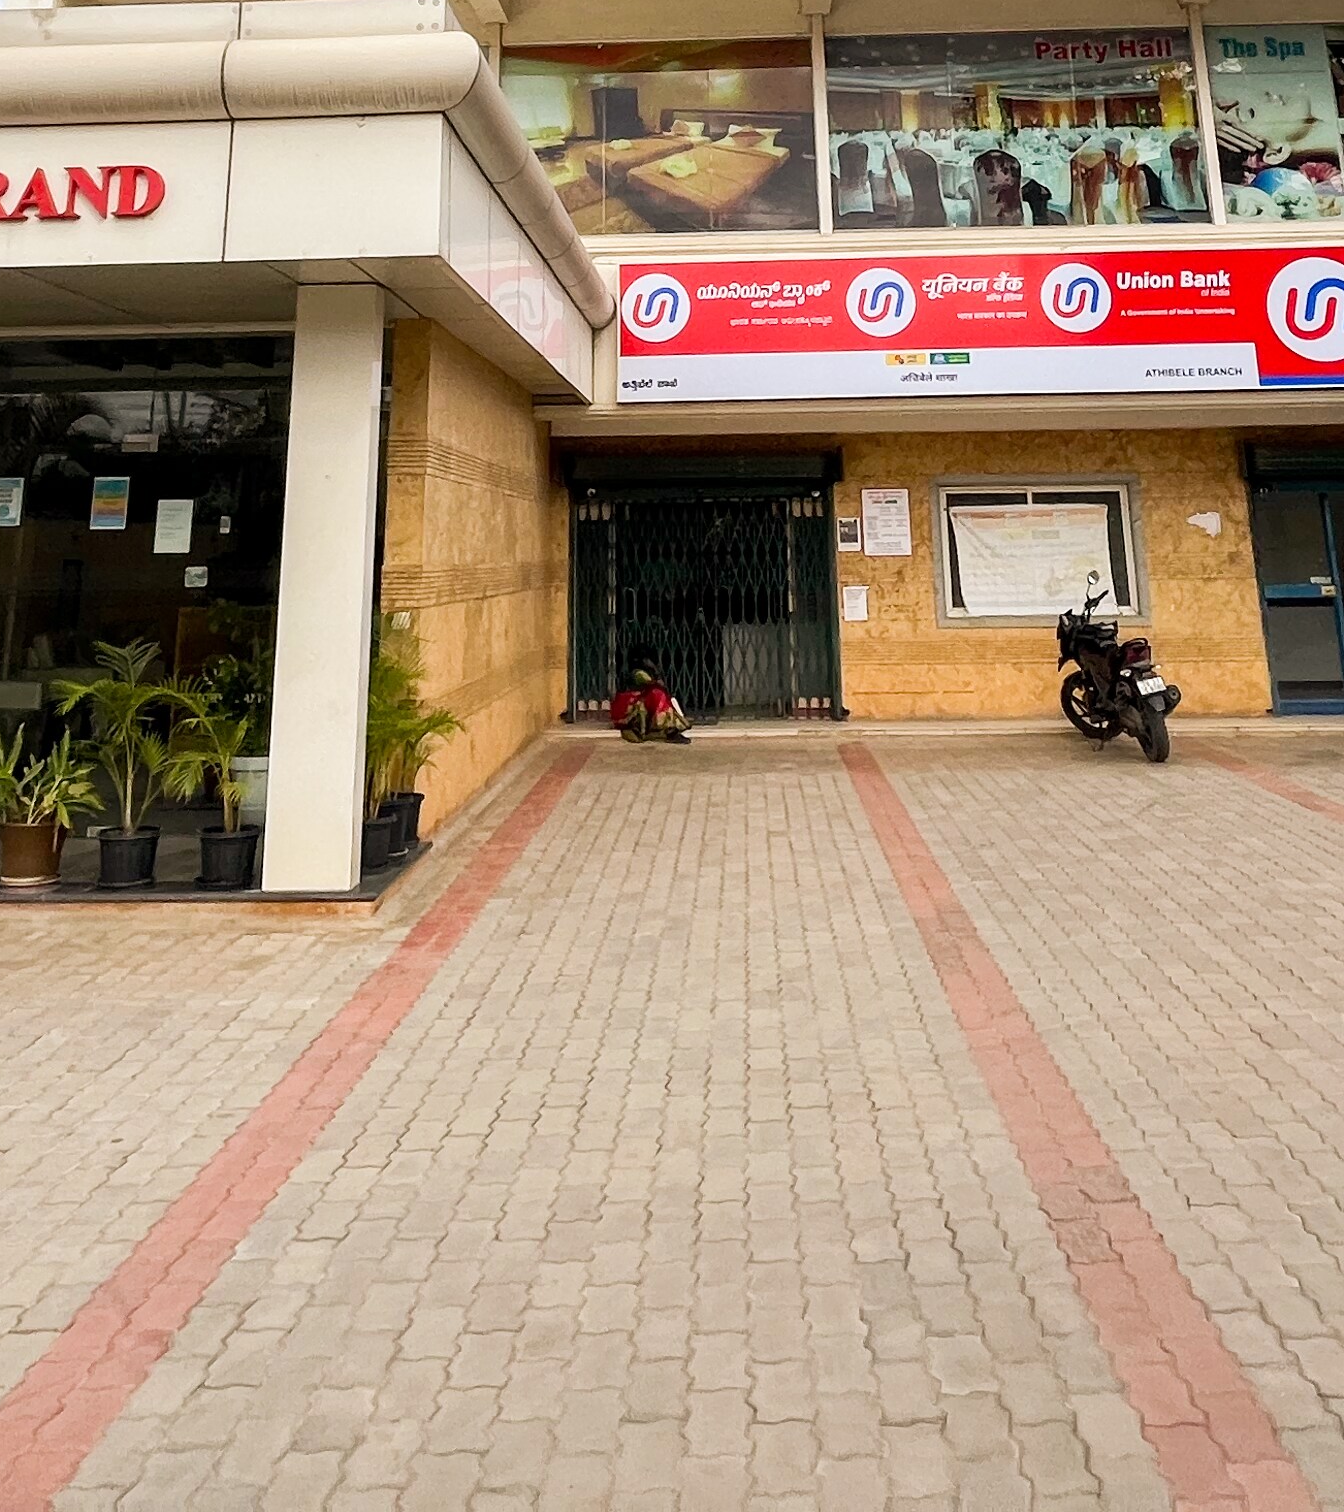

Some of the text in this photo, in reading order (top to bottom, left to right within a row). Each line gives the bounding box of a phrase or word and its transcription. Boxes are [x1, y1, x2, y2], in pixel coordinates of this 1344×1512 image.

[1033, 37, 1173, 63] Party Hall
[1218, 36, 1307, 61] The Spa
[697, 280, 781, 300] ಯೂನಿಯನ್
[921, 271, 1025, 299] यूनियन बैंक
[1116, 269, 1231, 290] Union Bank
[1145, 367, 1243, 377] ATHIBELE BRANCH
